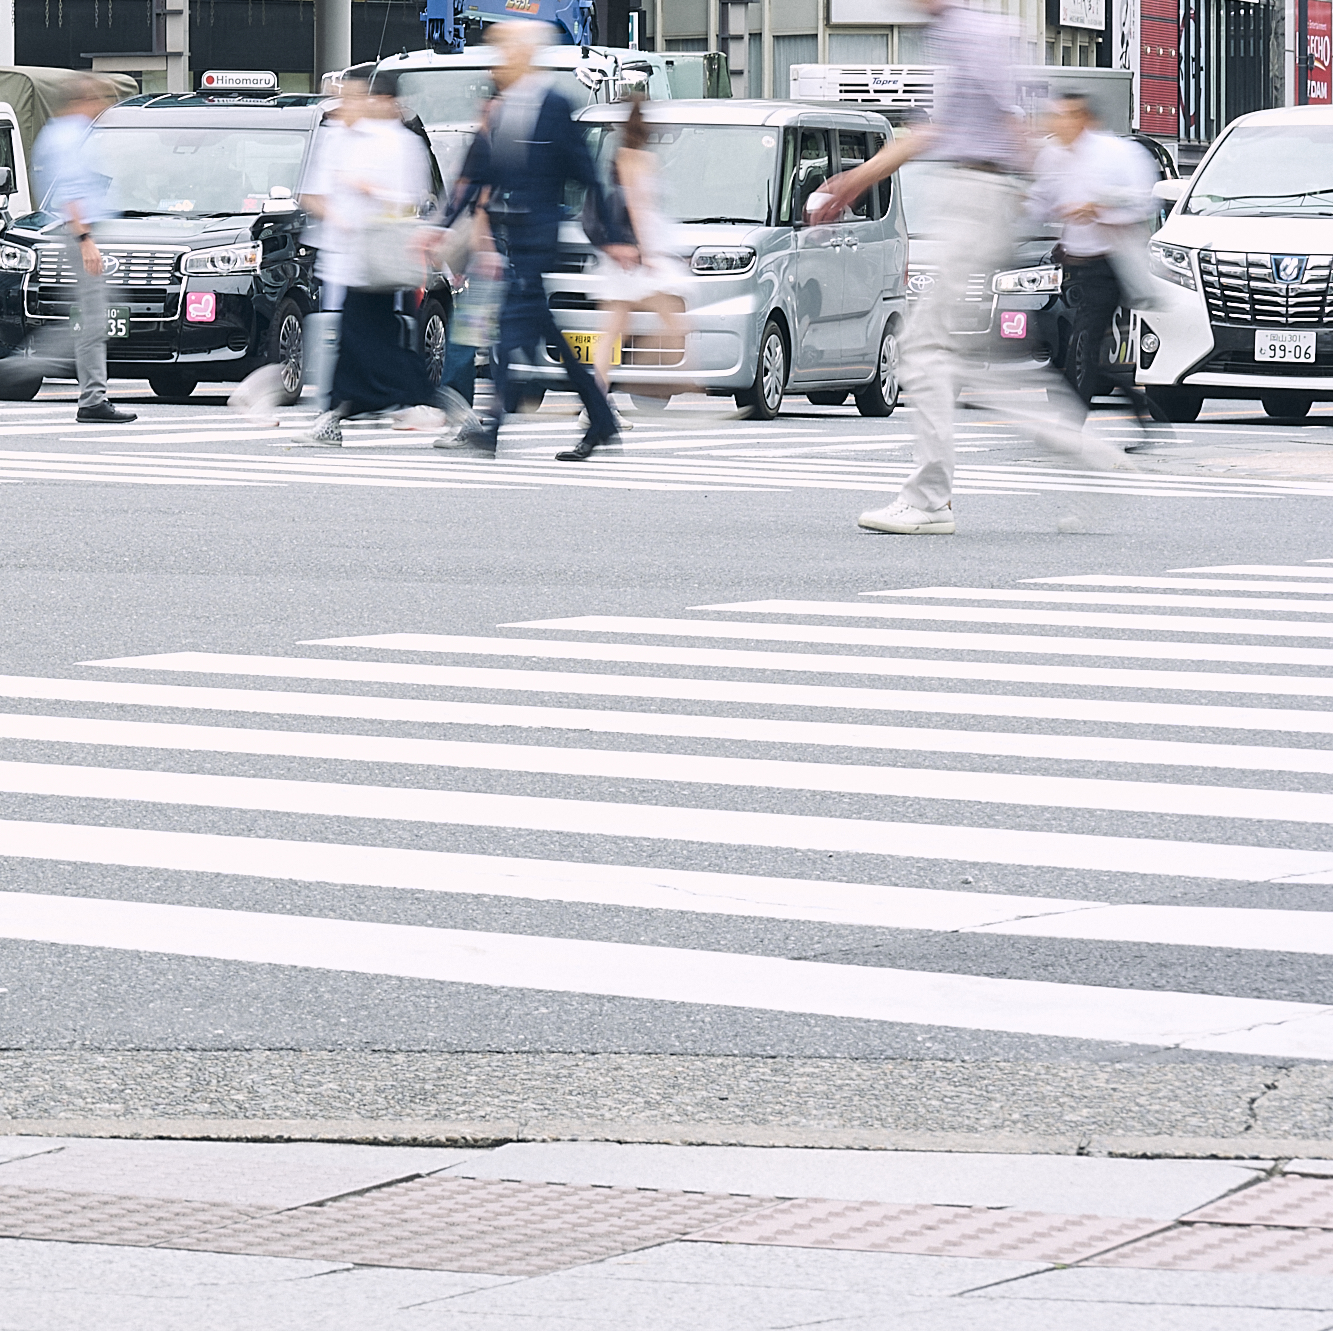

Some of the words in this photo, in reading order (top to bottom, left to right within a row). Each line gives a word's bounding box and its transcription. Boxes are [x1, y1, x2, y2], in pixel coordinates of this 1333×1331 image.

[216, 75, 271, 85] Hinomaru
[872, 77, 899, 86] Topre
[1268, 344, 1312, 360] 99-06
